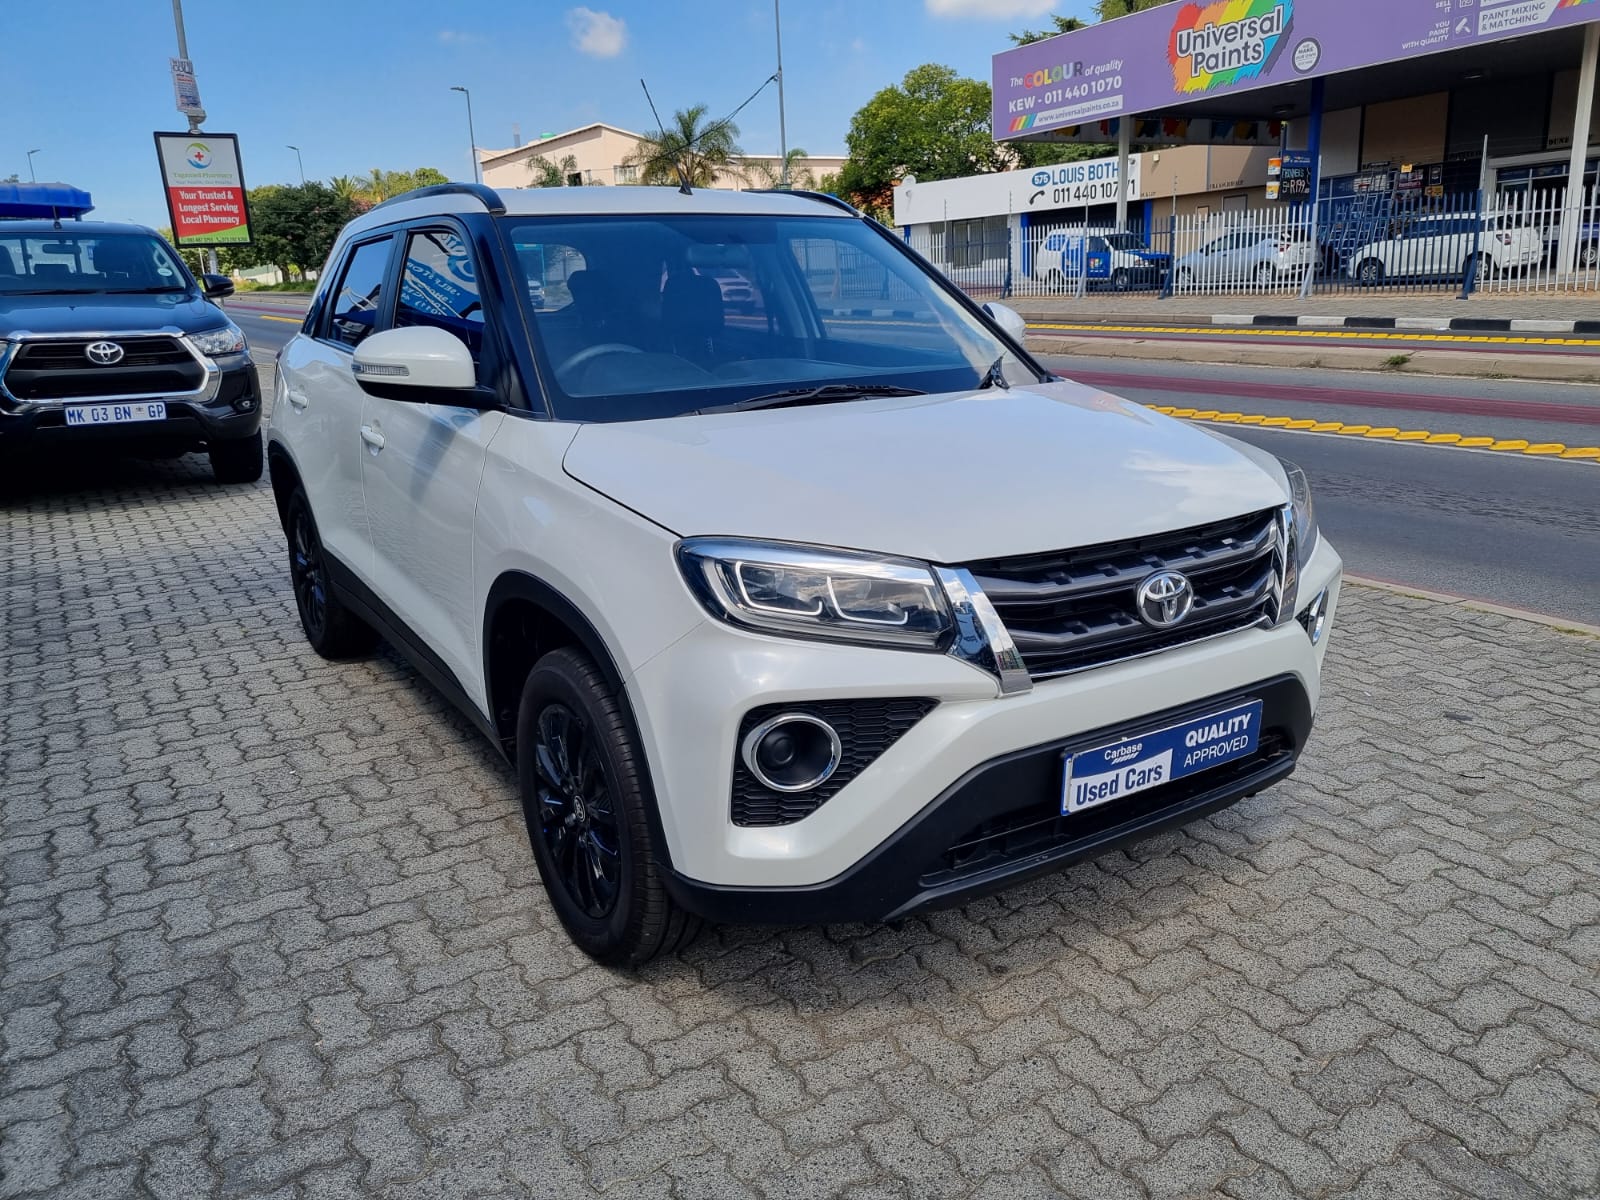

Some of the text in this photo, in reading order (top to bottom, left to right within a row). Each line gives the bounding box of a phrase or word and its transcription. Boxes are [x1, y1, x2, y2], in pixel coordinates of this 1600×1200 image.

[1482, 1, 1546, 22] PAINT MIXING
[1489, 12, 1539, 30] MATCHING
[1177, 7, 1282, 56] Universal
[1429, 27, 1449, 37] PAINT
[1435, 20, 1450, 28] YOU
[1420, 34, 1449, 46] QUALITY
[1192, 40, 1263, 75] Paints
[1010, 59, 1124, 89] The COLOUR of quality
[1008, 95, 1036, 113] KEW
[1044, 89, 1063, 105] 011
[1065, 83, 1089, 100] 440
[1090, 75, 1123, 95] 1070
[1038, 100, 1120, 123] www.universalpaints.co.za
[1034, 162, 1119, 186] 575 LOUIS BOTH
[178, 190, 234, 200] Your Trusted &
[1053, 187, 1071, 204] 011
[1073, 184, 1097, 201] 440
[178, 202, 239, 214] Longest Serving
[181, 214, 240, 226] Local Pharmacy
[67, 404, 164, 424] MK 03 BN GP
[1184, 712, 1253, 748] QUALITY
[1103, 741, 1144, 762] Carbase
[1183, 734, 1250, 769] APPROVED
[1075, 763, 1164, 806] Used Cars
